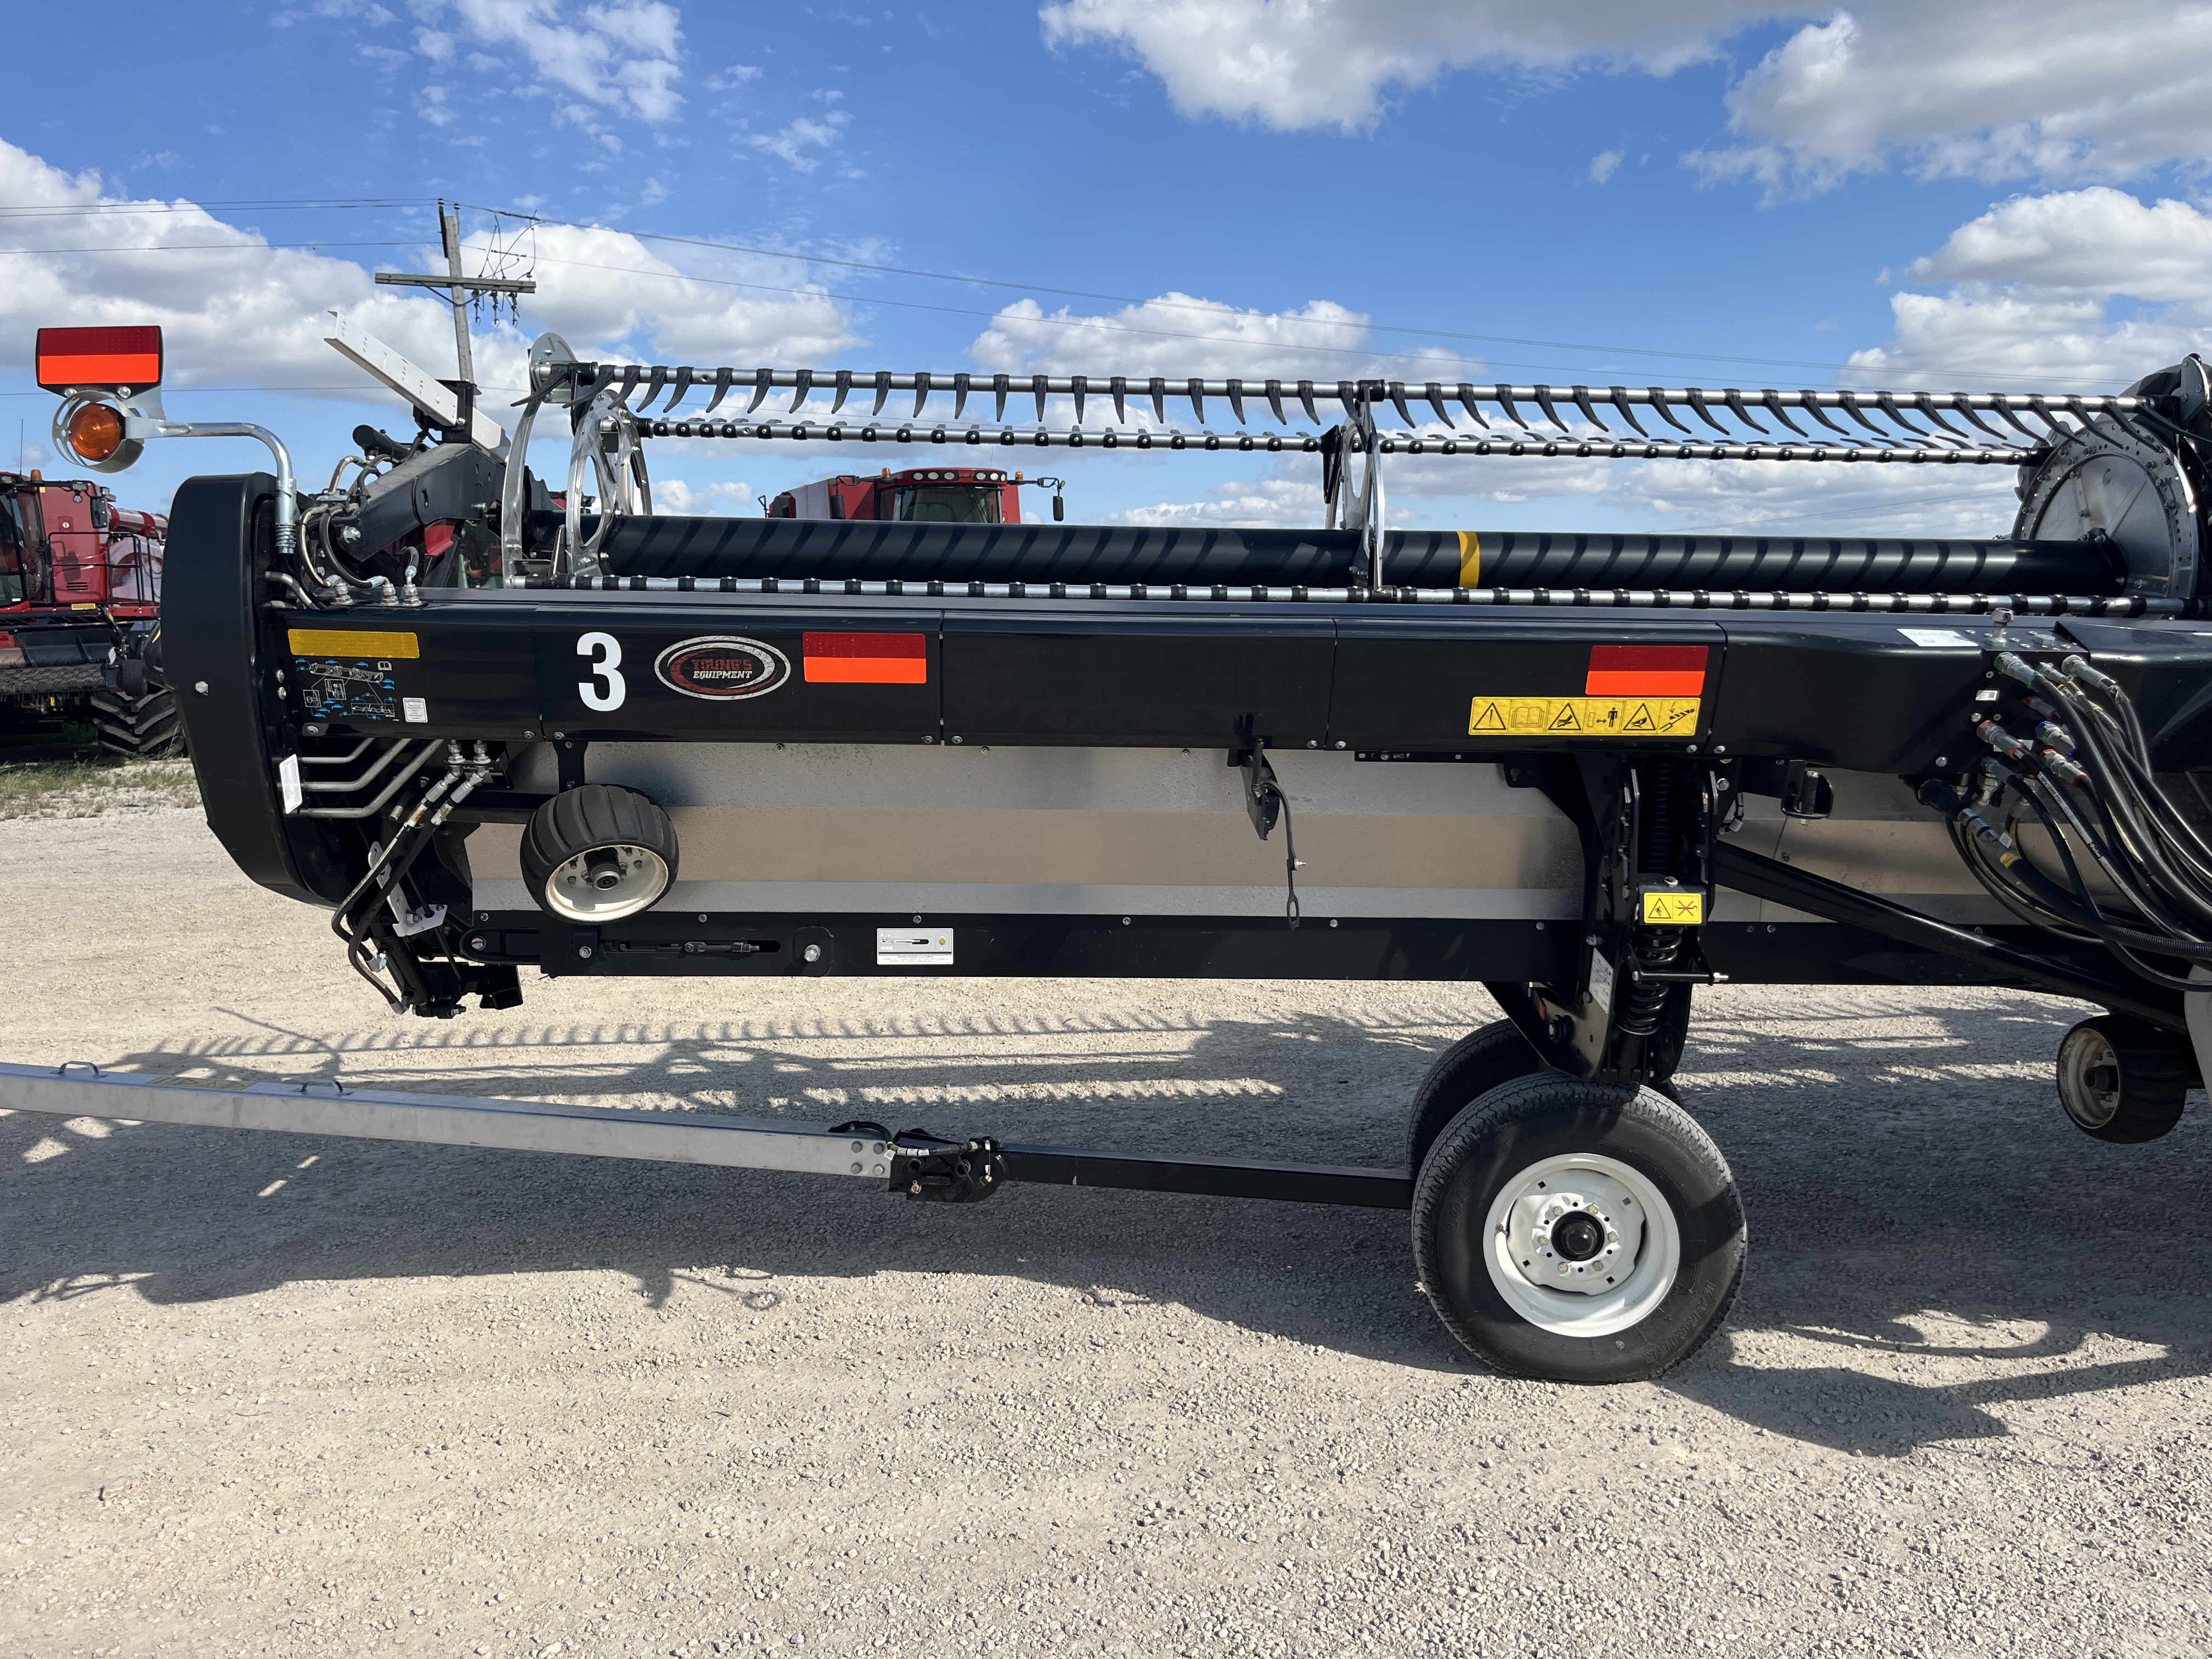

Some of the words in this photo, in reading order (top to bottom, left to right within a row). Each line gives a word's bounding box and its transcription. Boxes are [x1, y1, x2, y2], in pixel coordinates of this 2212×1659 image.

[691, 659, 752, 670] YOUNG'S
[577, 632, 625, 712] 3
[693, 670, 752, 680] EQUIPMENT
